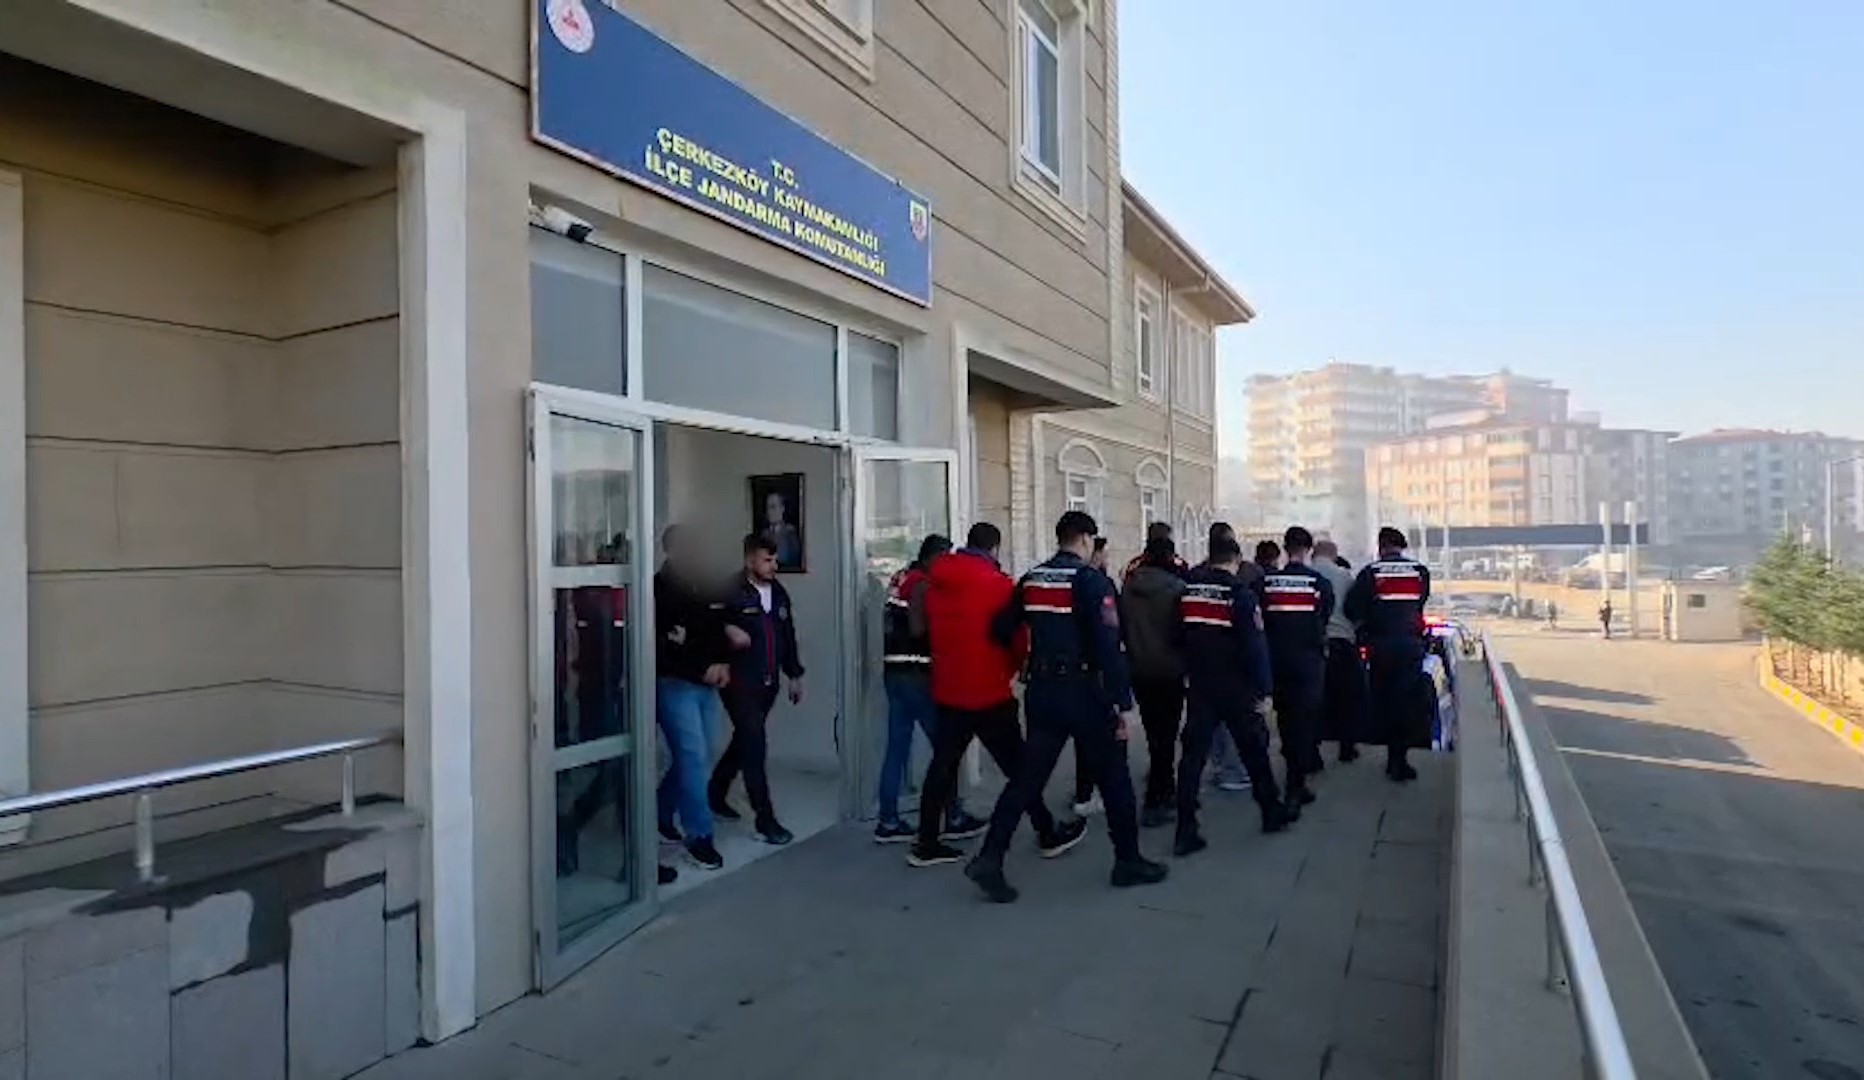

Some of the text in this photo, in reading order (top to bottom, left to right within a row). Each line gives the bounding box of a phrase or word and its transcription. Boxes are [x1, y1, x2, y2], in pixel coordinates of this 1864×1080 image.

[656, 127, 769, 197] ÇERKEZKÖY
[771, 159, 799, 189] T.C.
[645, 144, 885, 277] İLÇE JANDARMA KOMUTANLIĞI
